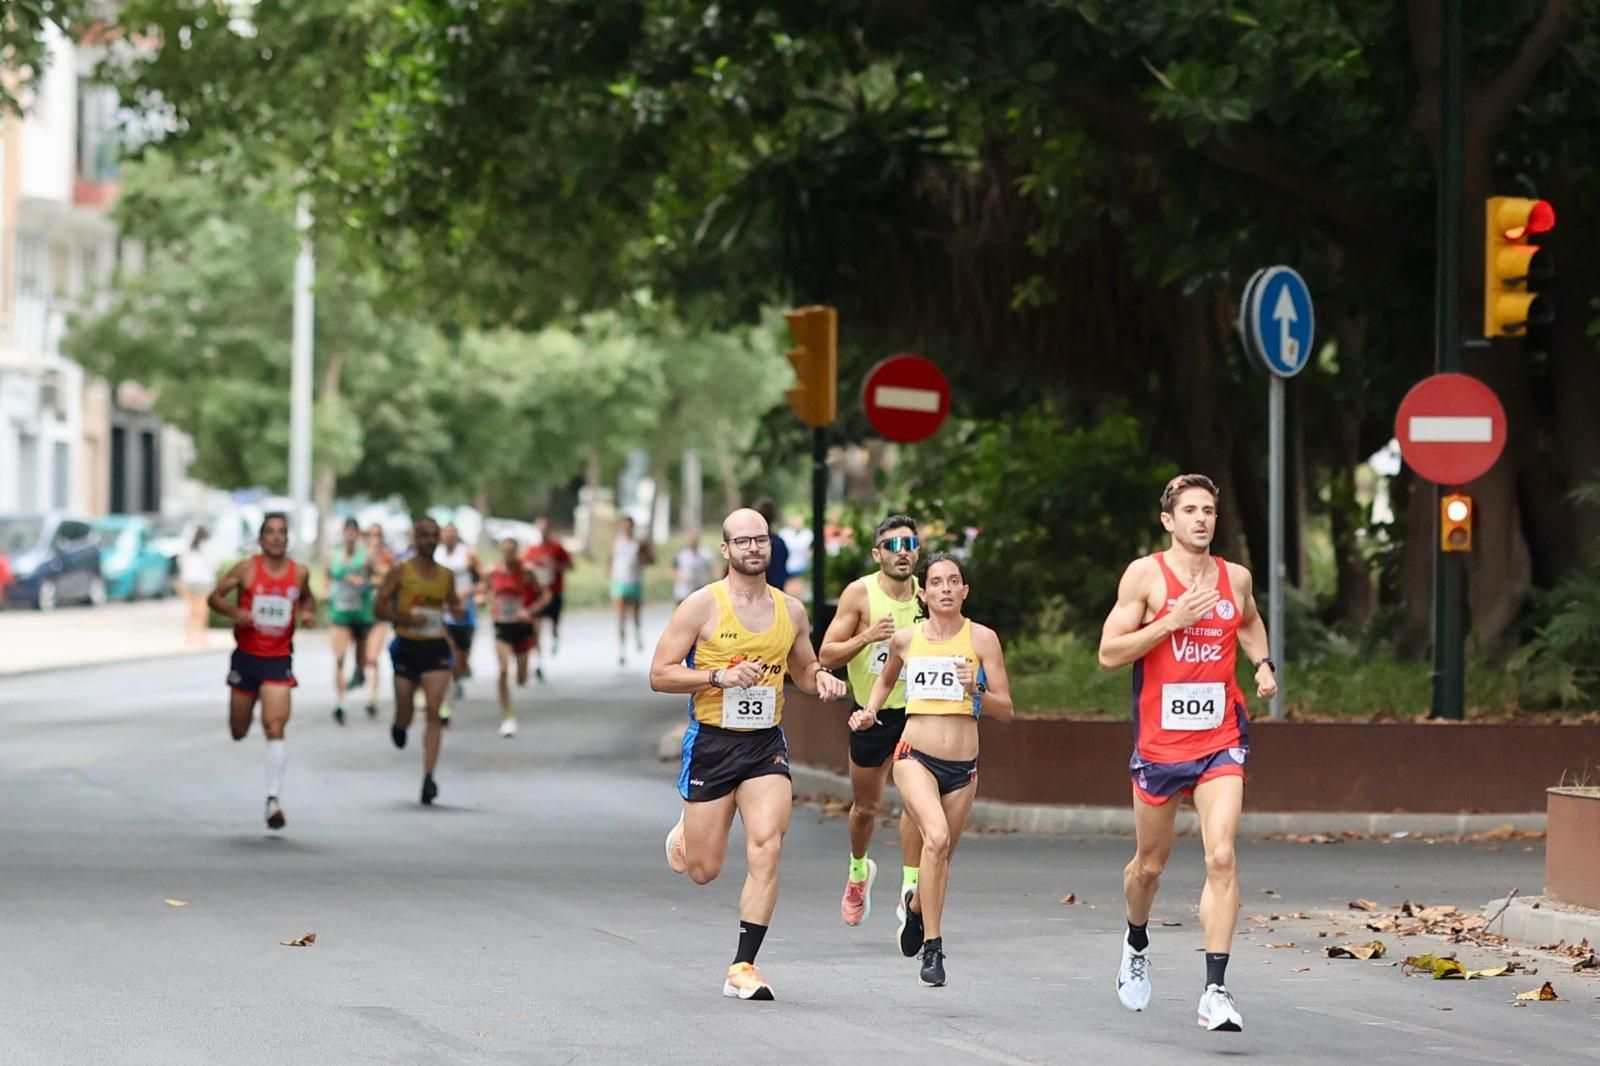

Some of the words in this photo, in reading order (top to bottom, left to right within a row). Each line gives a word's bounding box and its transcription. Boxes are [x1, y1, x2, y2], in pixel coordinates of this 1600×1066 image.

[1183, 627, 1223, 637] ATLETISMO
[1171, 632, 1223, 663] Vélez
[914, 672, 954, 686] 476
[737, 700, 763, 715] 33
[1171, 699, 1215, 715] 804
